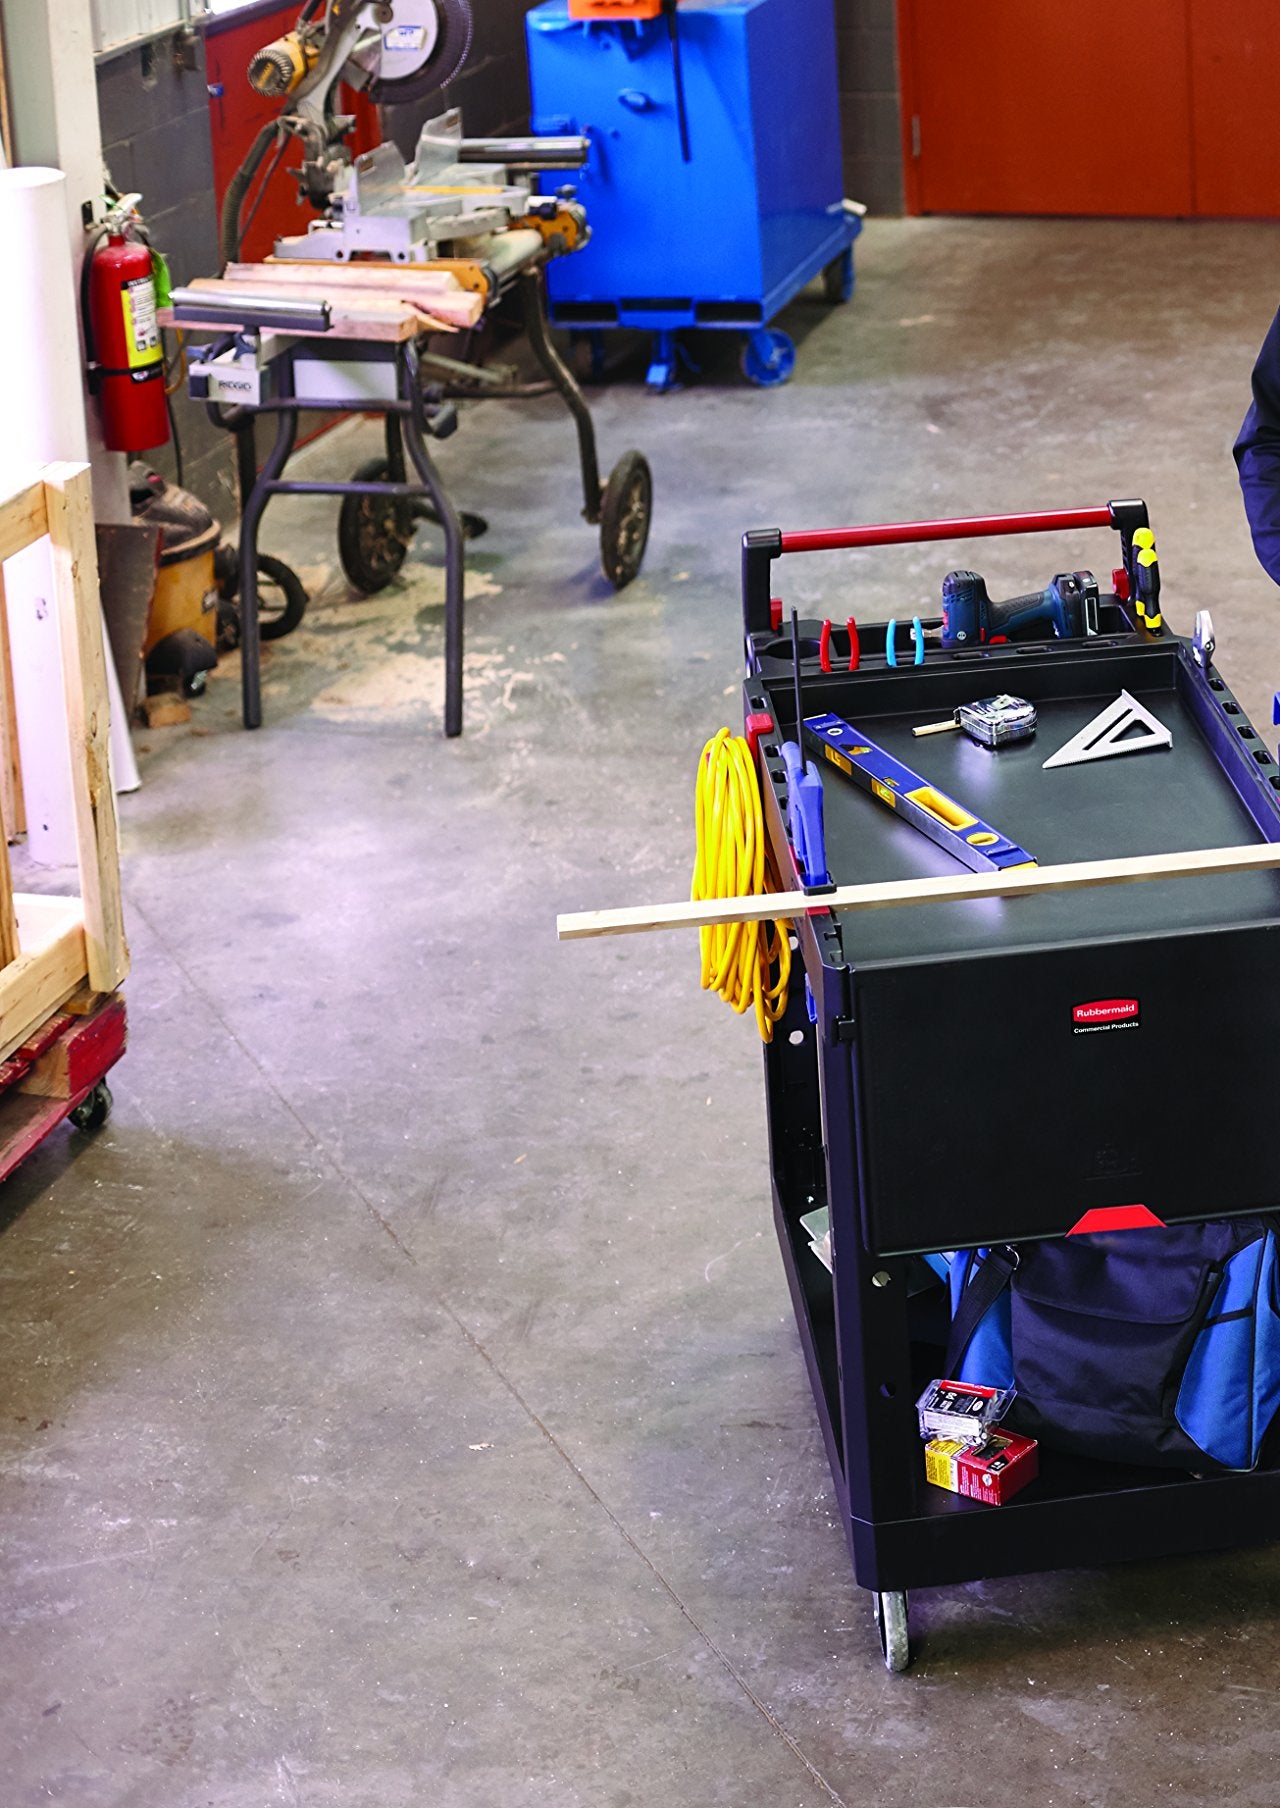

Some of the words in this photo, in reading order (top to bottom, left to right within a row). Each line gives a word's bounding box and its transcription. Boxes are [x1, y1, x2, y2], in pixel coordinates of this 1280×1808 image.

[1076, 1004, 1135, 1017] Rubbermaid
[1073, 1024, 1110, 1034] Commercial
[1111, 1021, 1139, 1030] Products
